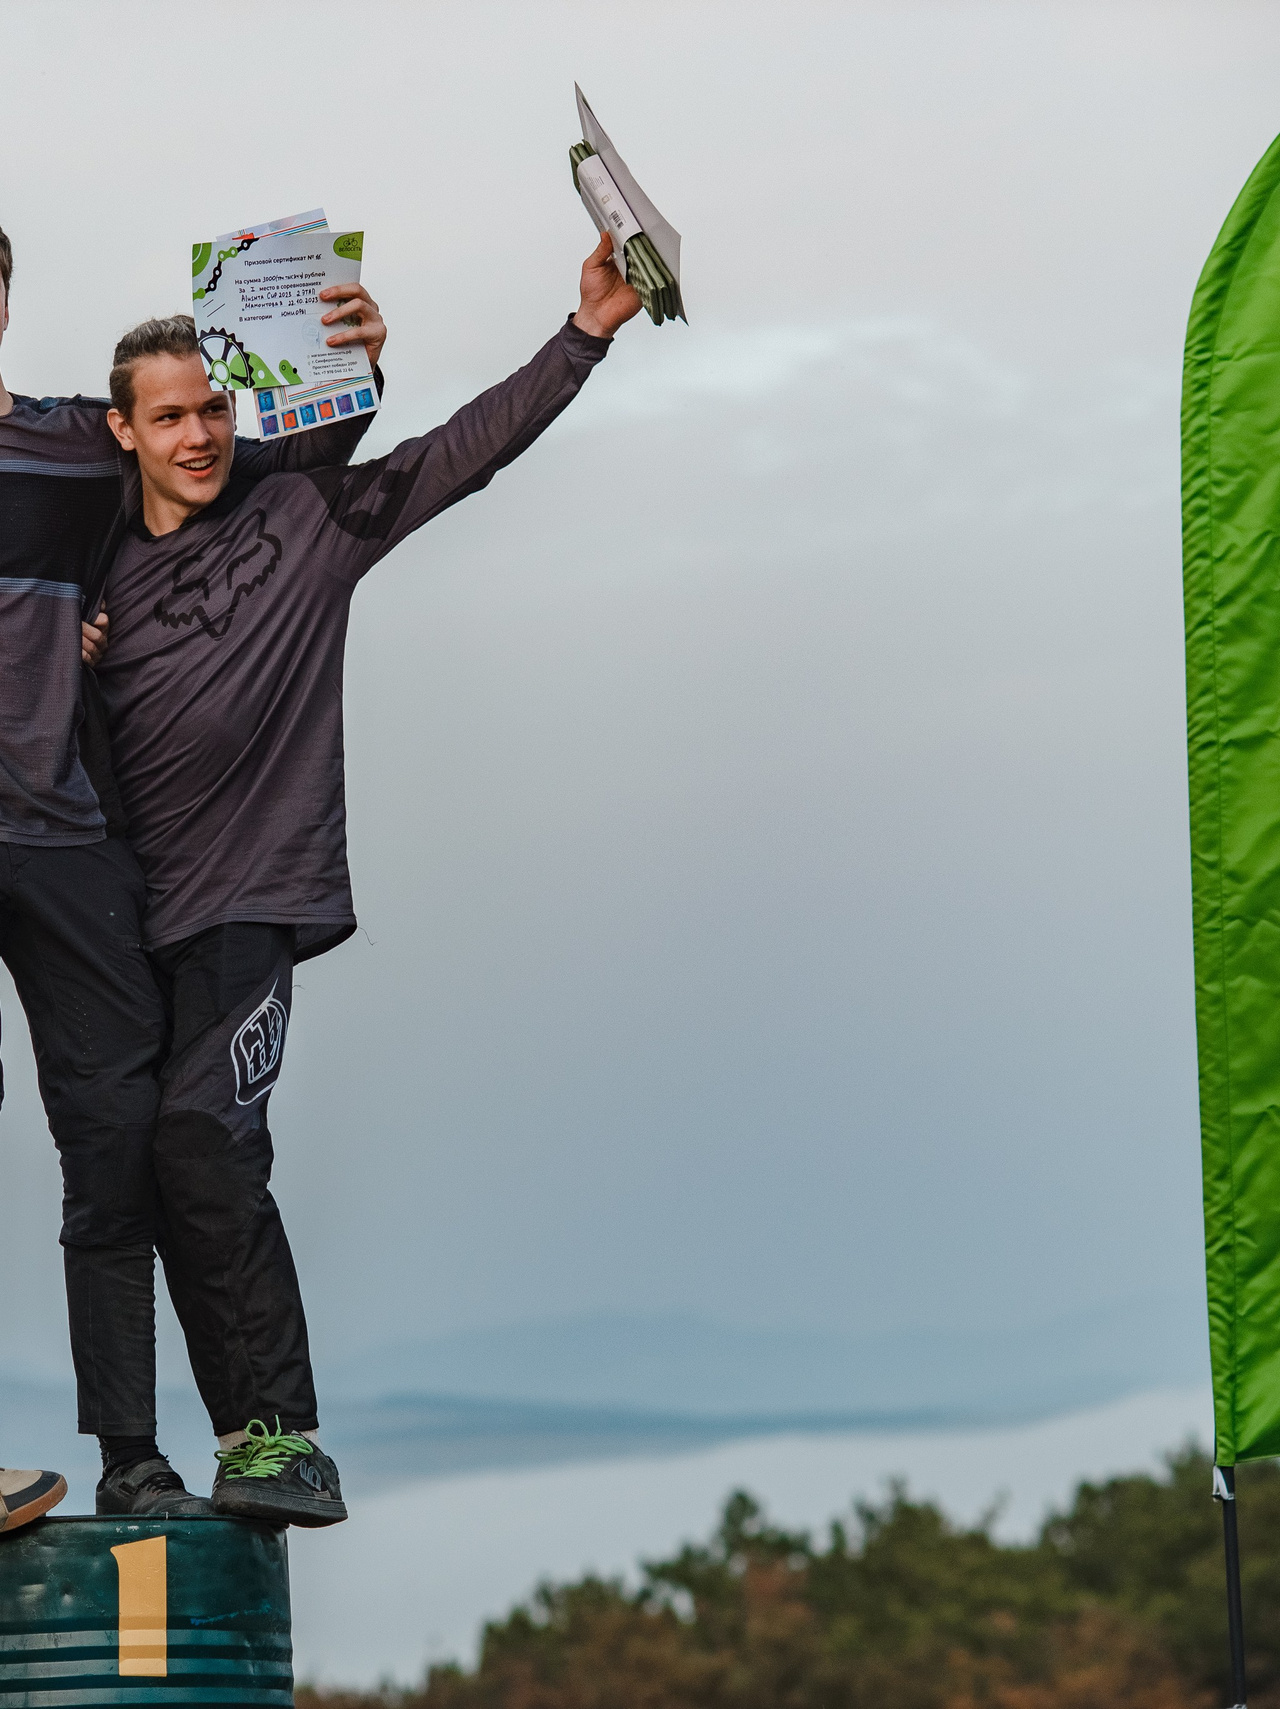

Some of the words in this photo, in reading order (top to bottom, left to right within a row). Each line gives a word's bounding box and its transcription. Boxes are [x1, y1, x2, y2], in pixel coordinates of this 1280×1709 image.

[244, 258, 272, 267] Призовой
[273, 255, 306, 264] сертификат
[304, 270, 325, 279] рублей
[260, 284, 273, 292] место
[280, 281, 322, 290] соревнованиях
[243, 314, 273, 322] категории
[111, 1536, 167, 1677] 1
